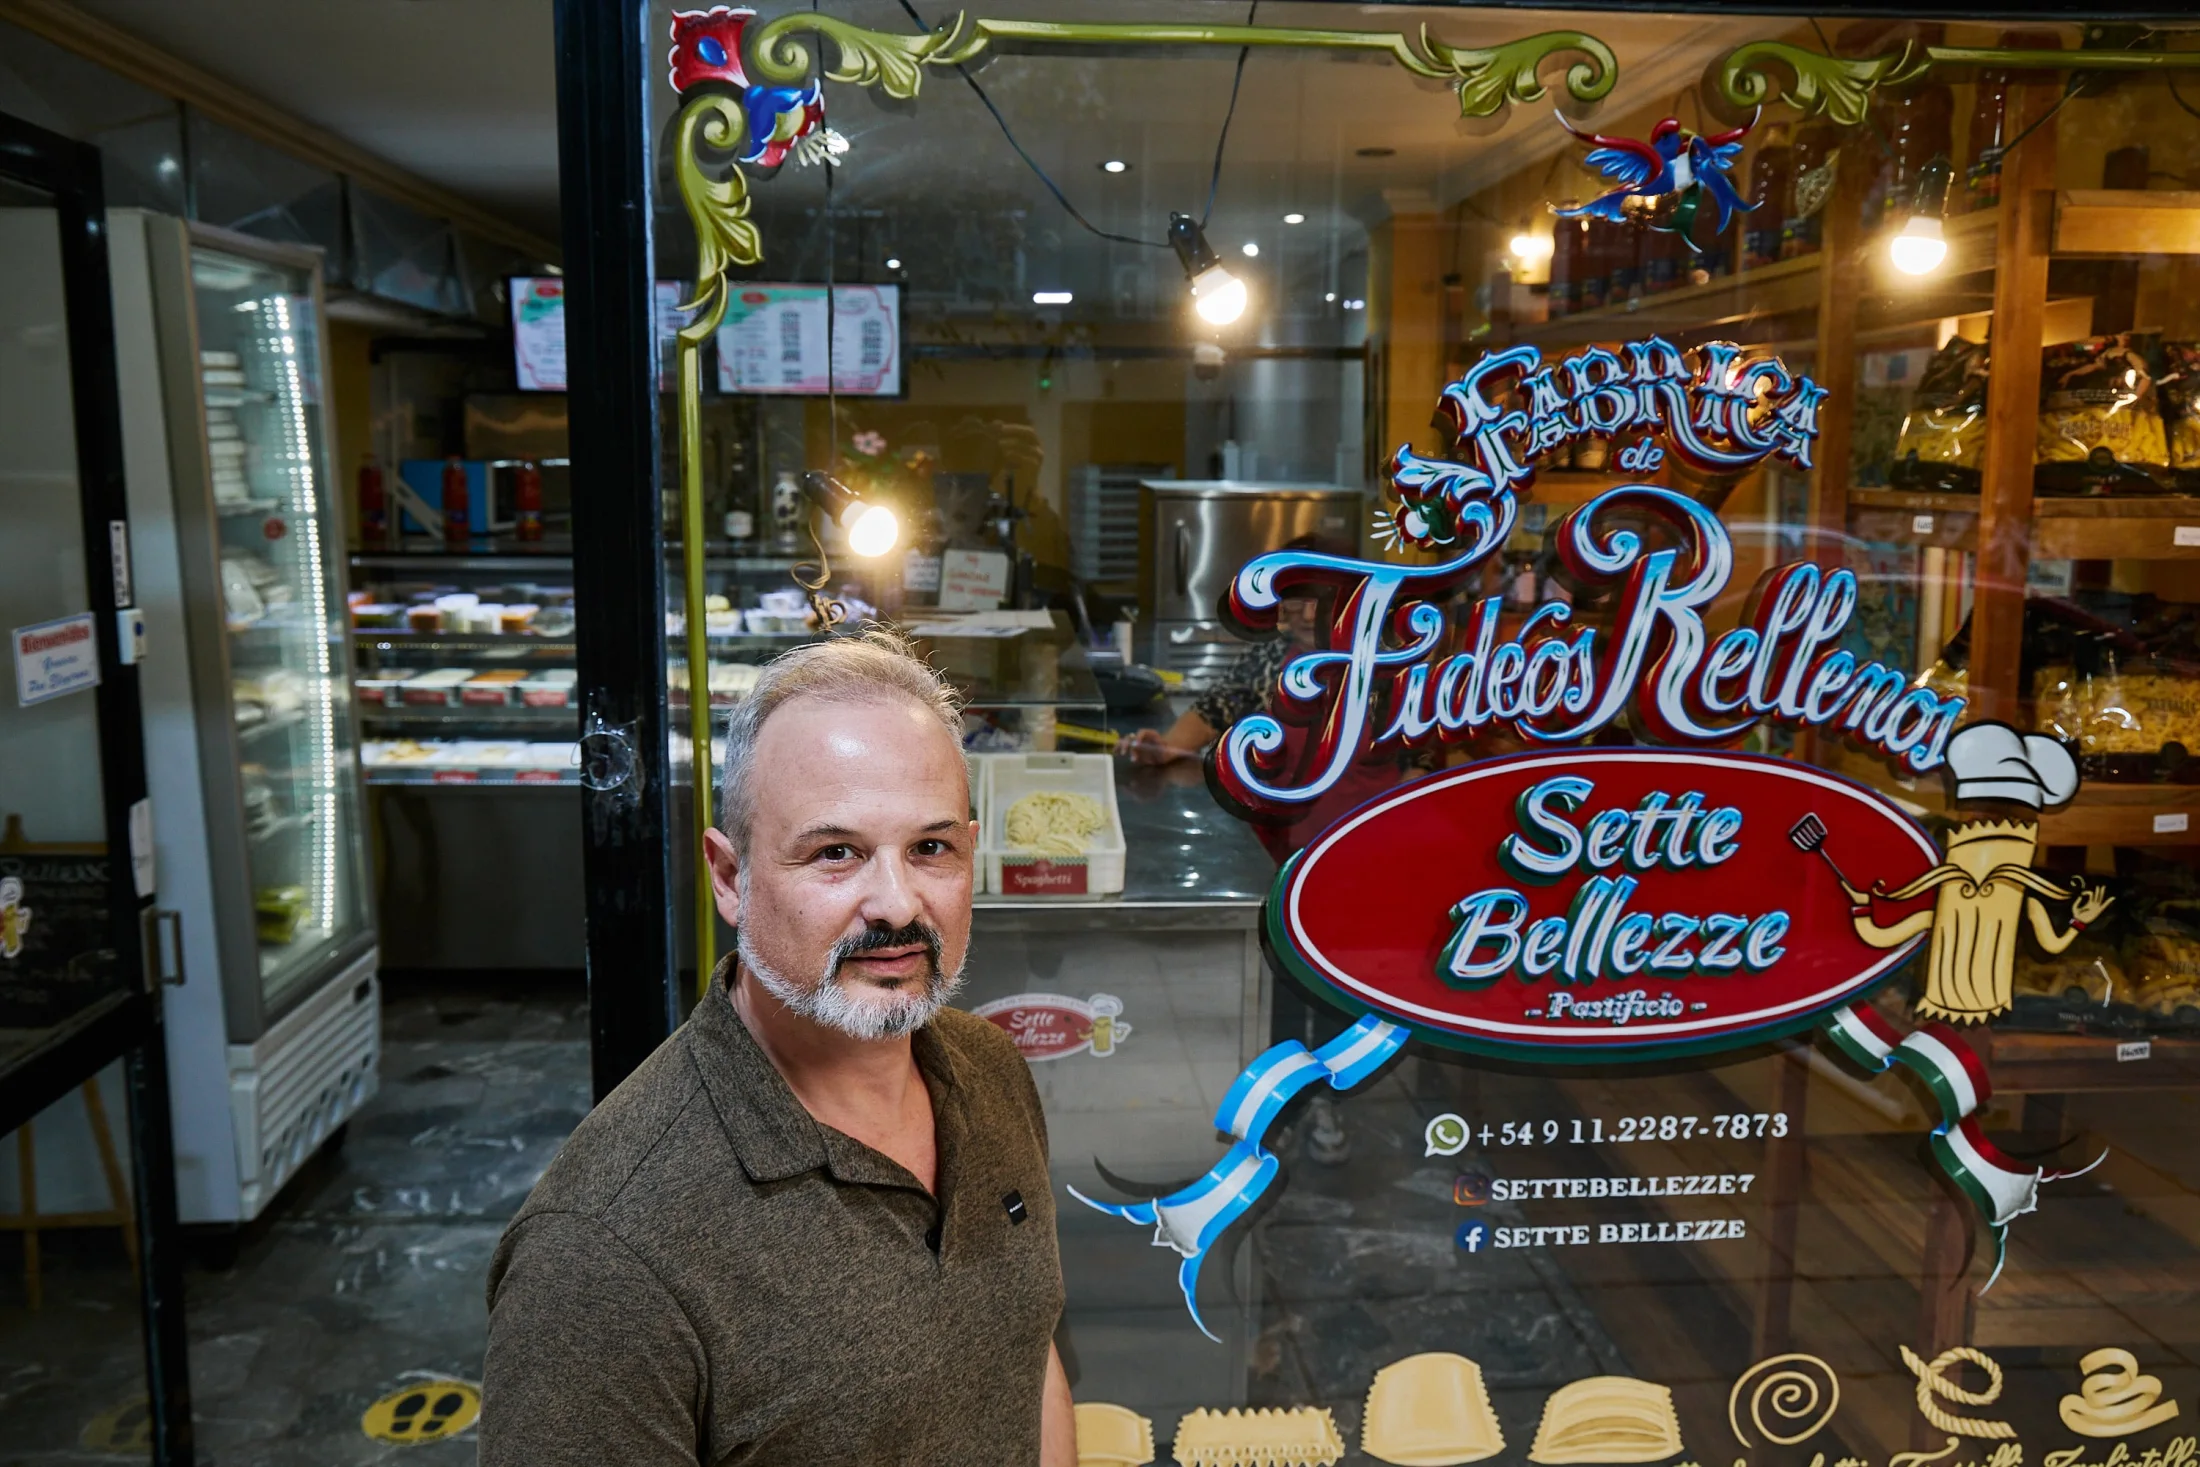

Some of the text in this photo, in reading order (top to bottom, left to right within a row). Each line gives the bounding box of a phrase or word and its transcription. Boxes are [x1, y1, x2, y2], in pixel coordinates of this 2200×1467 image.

[1441, 333, 1830, 497] FABRICA
[1617, 436, 1666, 472] de
[1226, 484, 1969, 803] Fidéos Rellenos
[1499, 774, 1743, 880] Sette
[1014, 872, 1073, 889] Spaghetti
[1438, 874, 1791, 985] Bellezze
[1009, 1010, 1055, 1029] Sette
[1546, 989, 1685, 1025] Pastificio
[1541, 1119, 1560, 1144] 9
[1569, 1112, 1790, 1144] 11.2287-7873
[1491, 1173, 1756, 1202] SETTEBELLEZZE7
[1493, 1218, 1747, 1250] SETTE BELLEZZE
